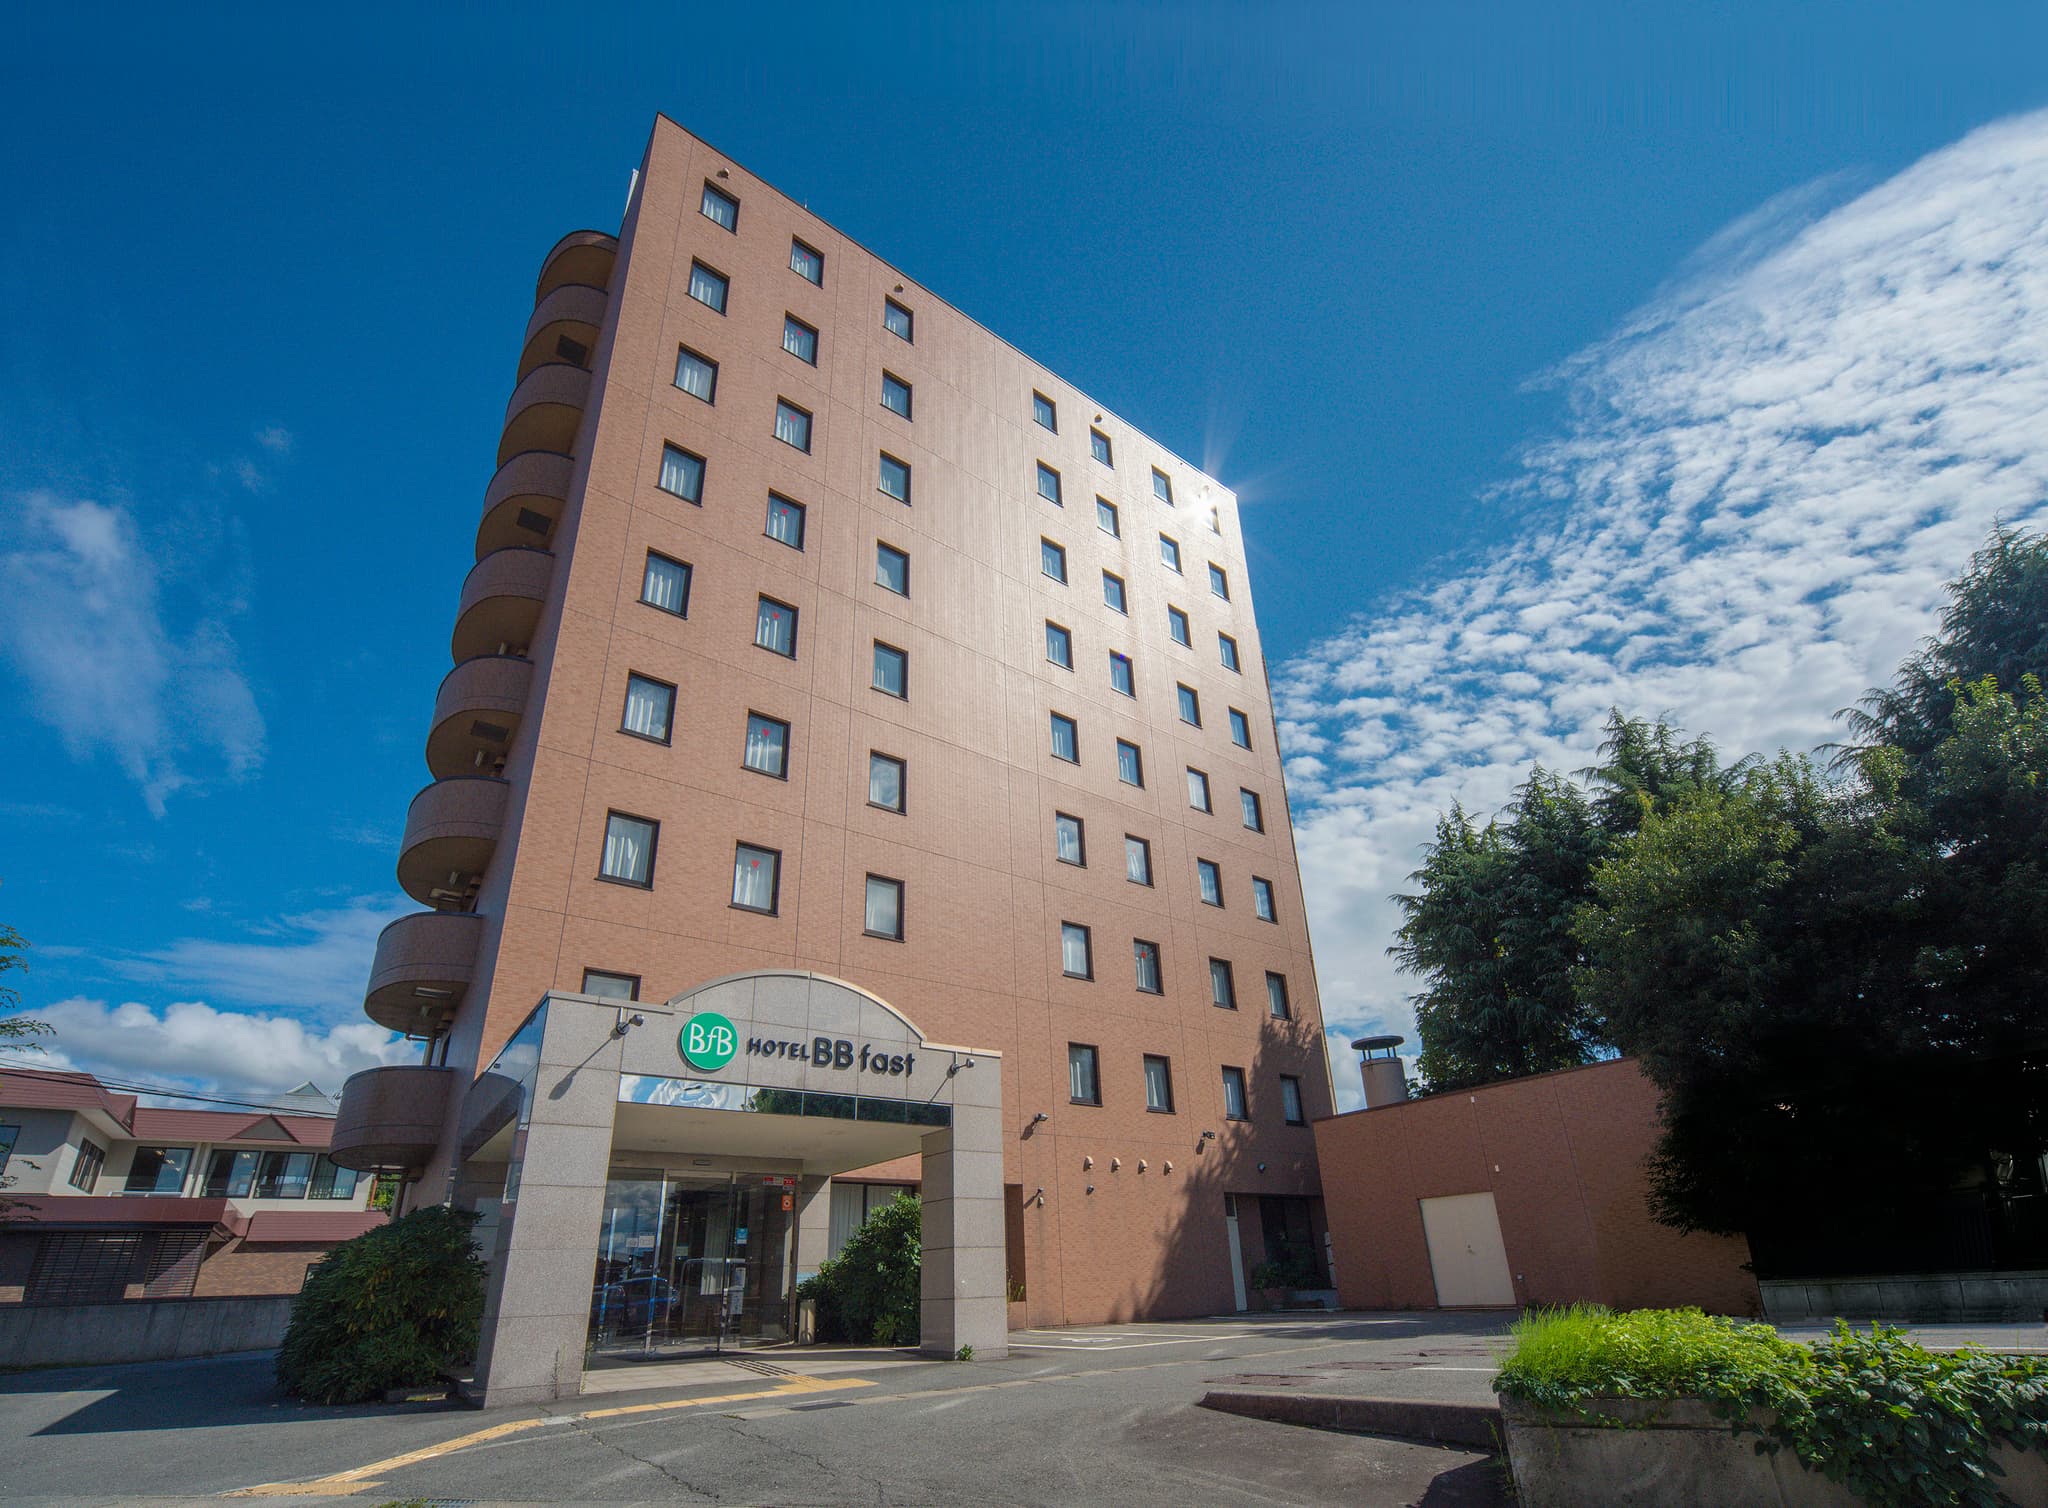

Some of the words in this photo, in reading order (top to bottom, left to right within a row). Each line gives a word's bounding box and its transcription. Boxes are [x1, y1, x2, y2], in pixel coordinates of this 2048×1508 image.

[746, 1037, 810, 1061] HOTEL
[812, 1037, 854, 1070] BB
[859, 1043, 915, 1078] fast
